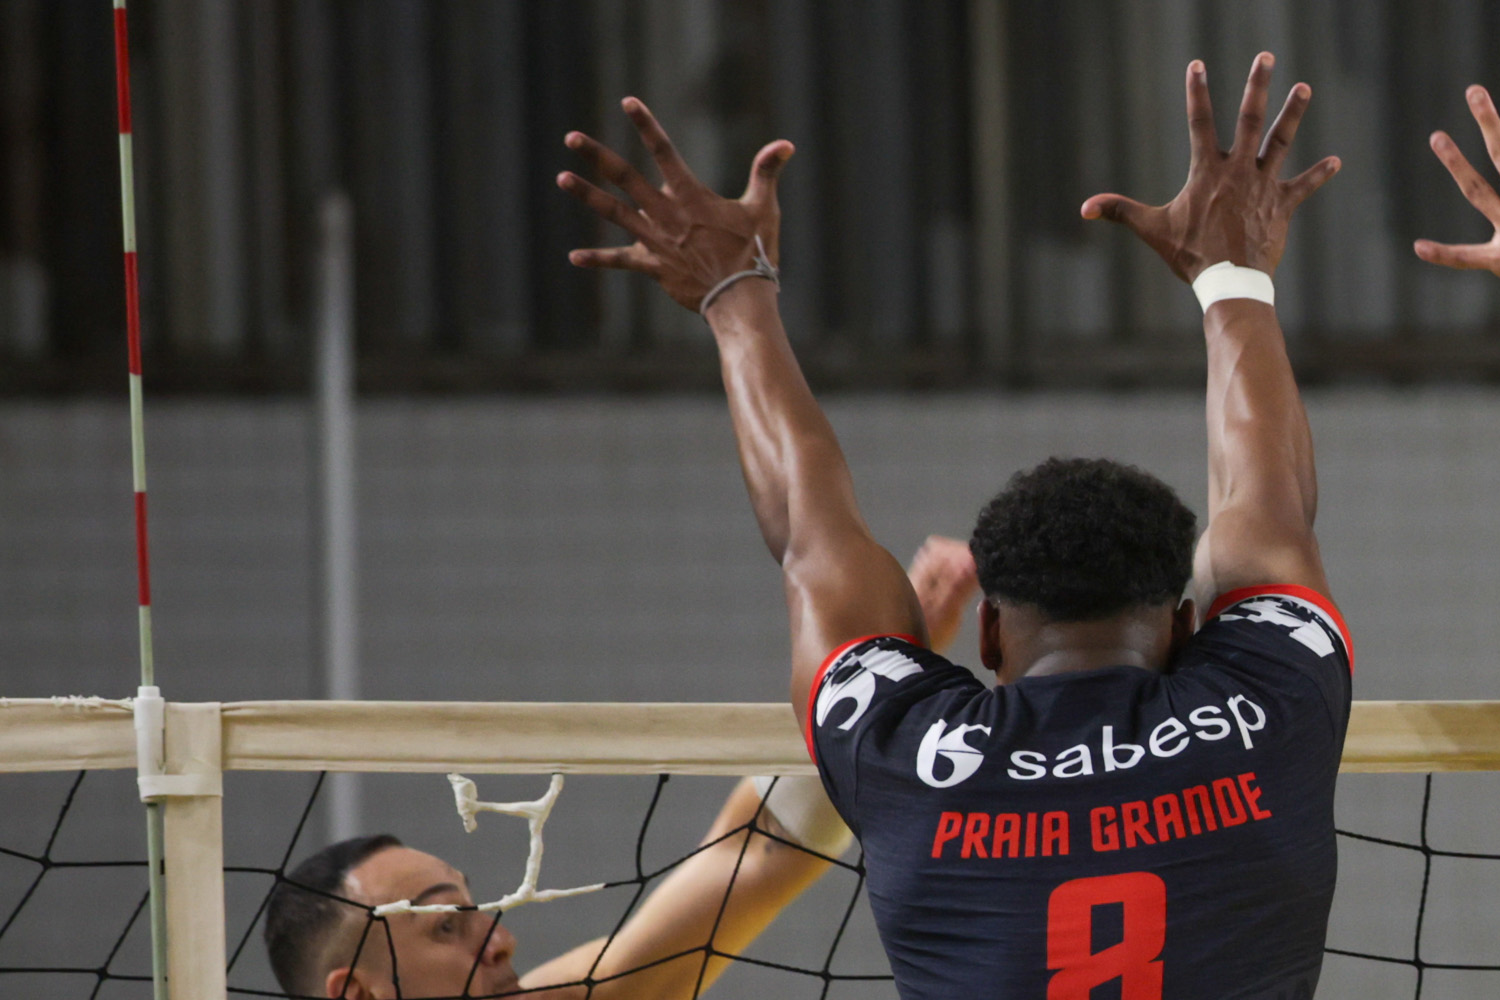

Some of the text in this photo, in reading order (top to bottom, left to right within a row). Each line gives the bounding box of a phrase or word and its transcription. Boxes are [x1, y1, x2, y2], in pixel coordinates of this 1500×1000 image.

[1006, 692, 1268, 782] sabesp
[931, 771, 1273, 860] PRAIA GRANDE
